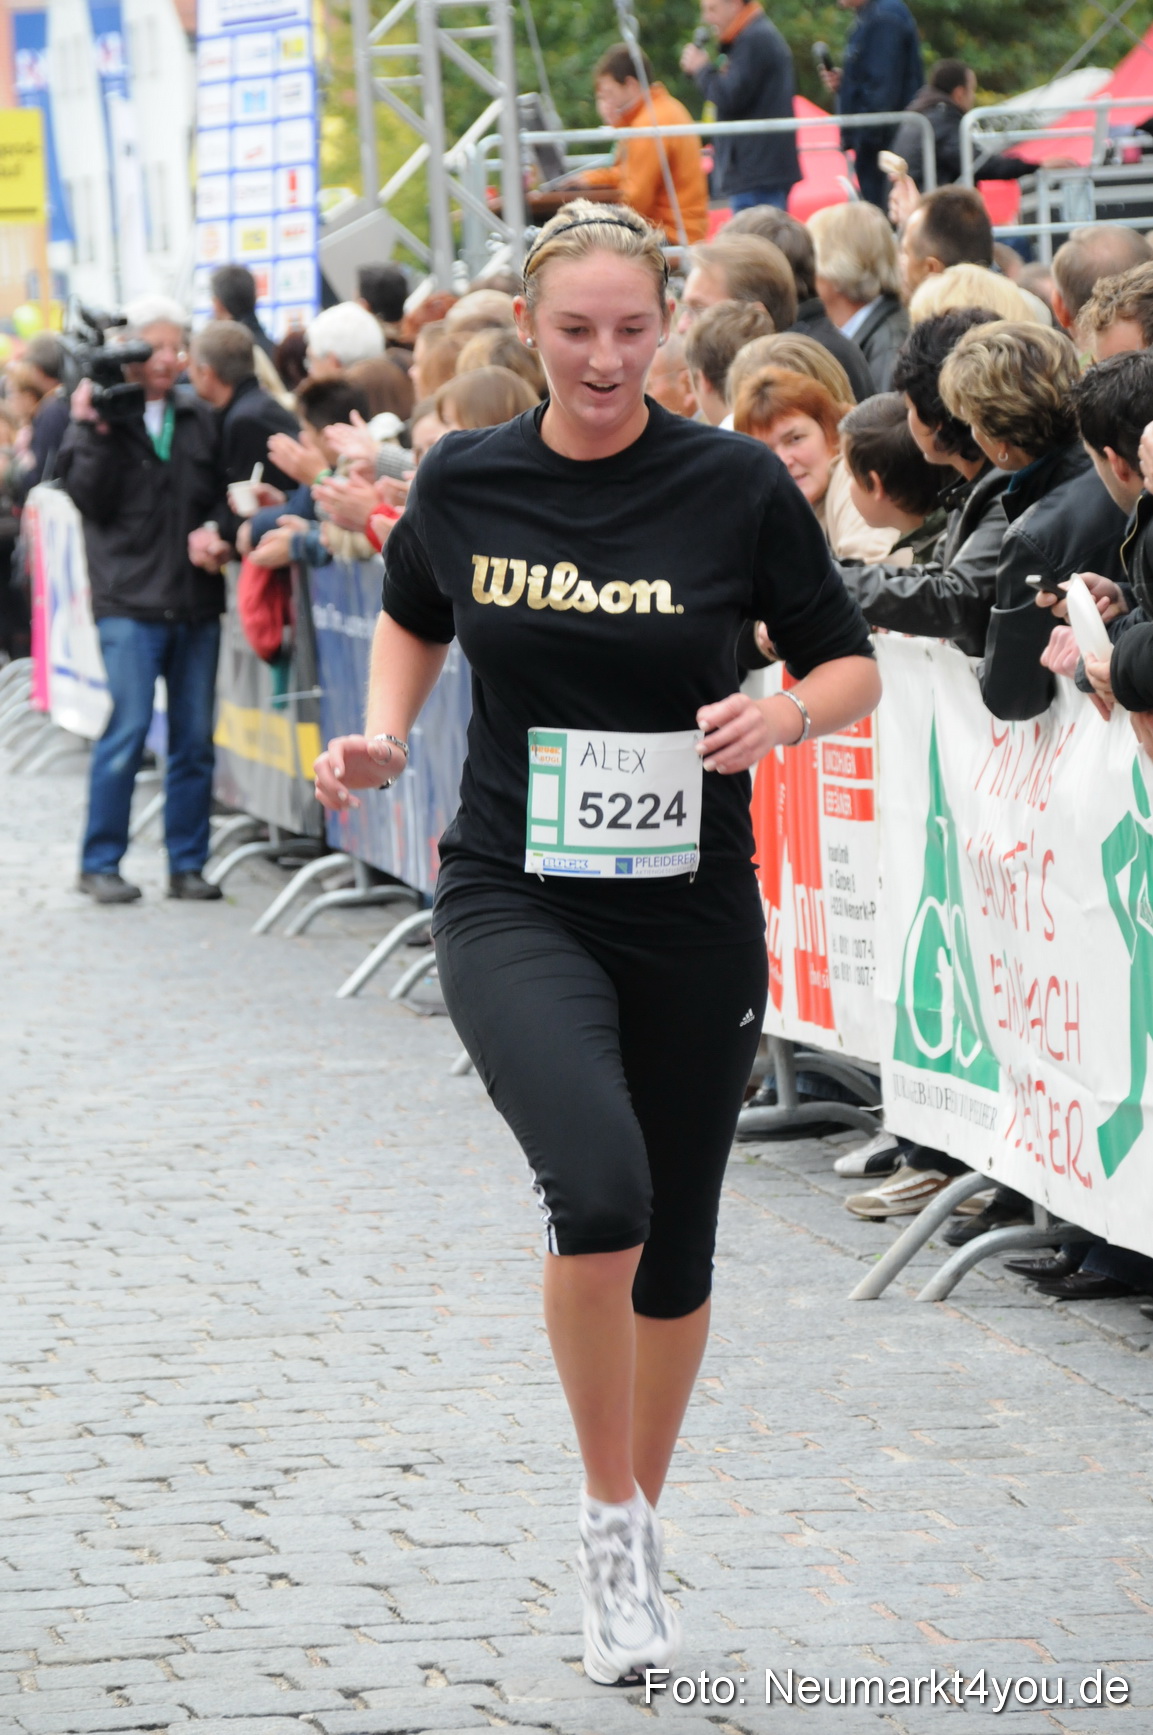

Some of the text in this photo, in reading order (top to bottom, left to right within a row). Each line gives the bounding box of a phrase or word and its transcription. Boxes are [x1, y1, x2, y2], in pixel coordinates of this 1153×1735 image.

[580, 741, 646, 774] ALEX
[578, 790, 687, 829] 5224
[635, 853, 696, 868] PFLEIDERER
